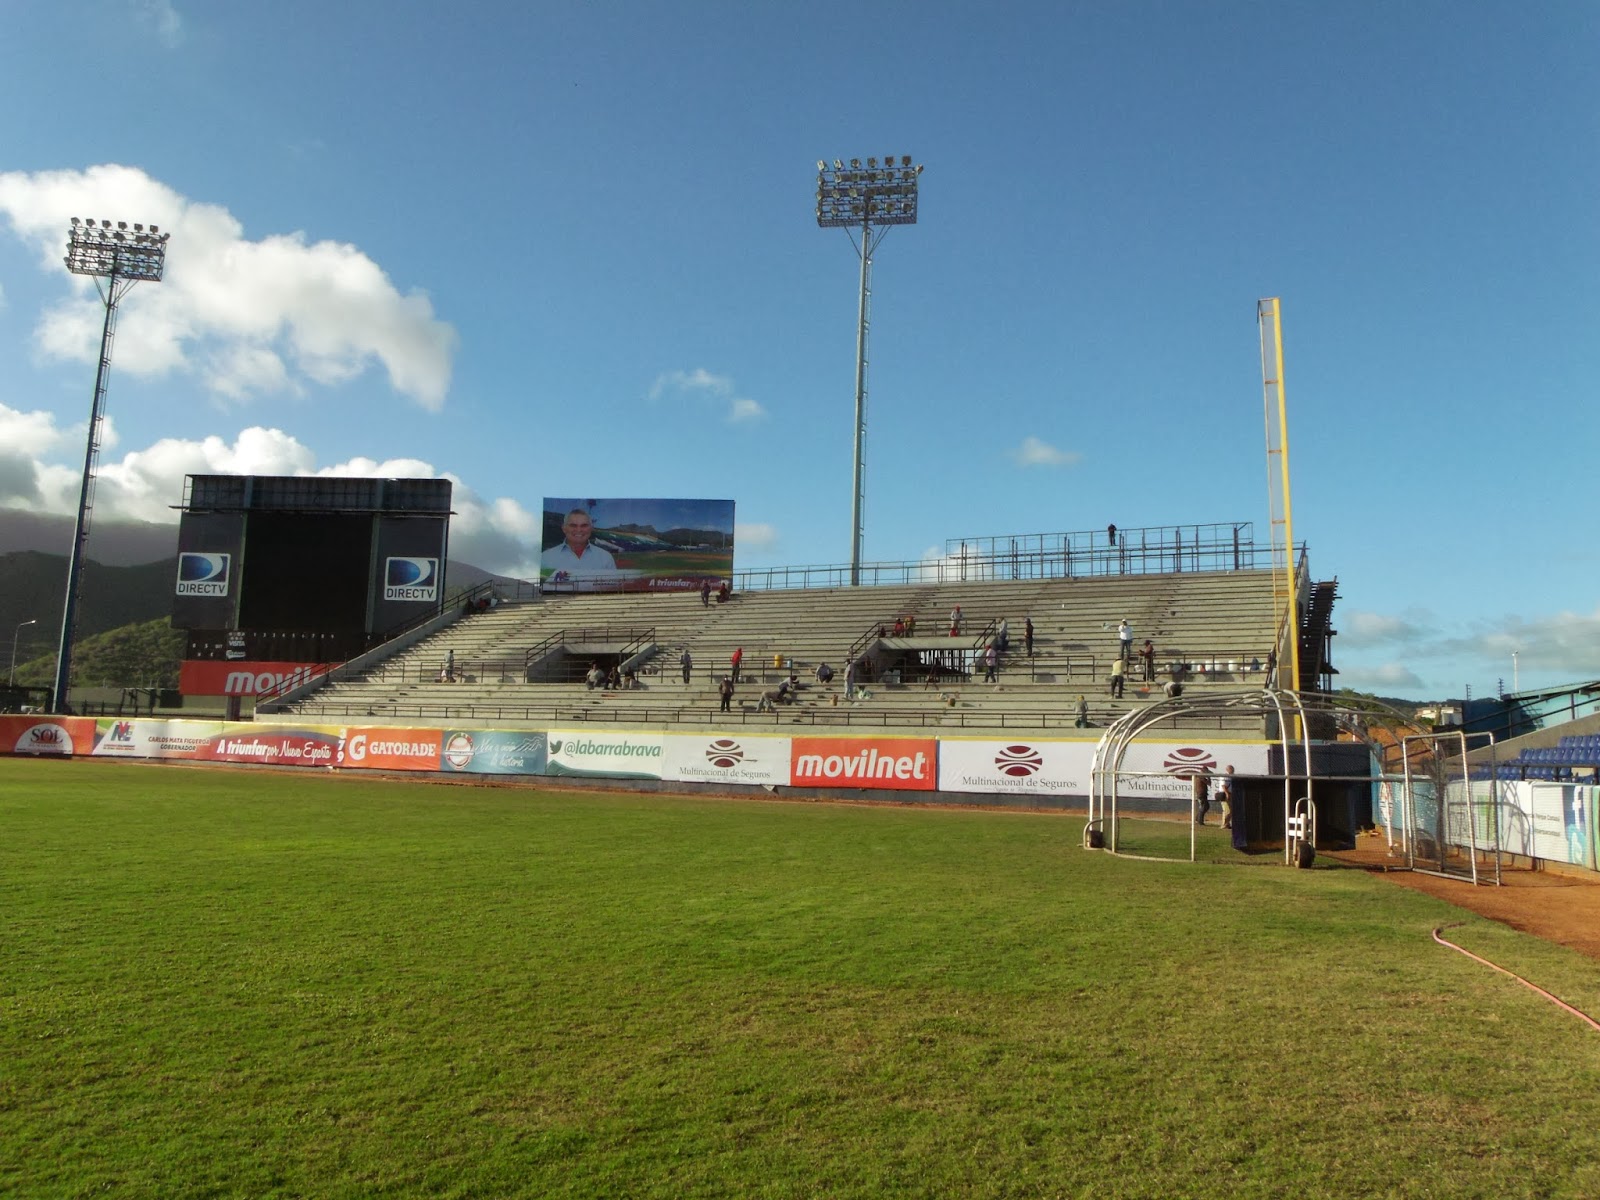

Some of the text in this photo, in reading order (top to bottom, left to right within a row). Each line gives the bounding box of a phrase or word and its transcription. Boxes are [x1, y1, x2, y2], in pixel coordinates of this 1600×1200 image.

[178, 583, 226, 594] DIRECTV
[386, 588, 434, 599] DIRECTV
[224, 666, 321, 694] movil
[31, 728, 64, 744] SOL
[217, 739, 226, 754] A
[227, 739, 267, 756] triunfar
[369, 741, 437, 757] GATORADE
[564, 740, 661, 757] @labarrabrava
[795, 748, 926, 779] movilnet
[679, 766, 771, 779] Multinacional de Seguros
[962, 776, 1024, 787] Multinacional
[1026, 778, 1038, 787] de
[1040, 779, 1077, 790] Seguros
[1128, 781, 1194, 792] Multinaciona
